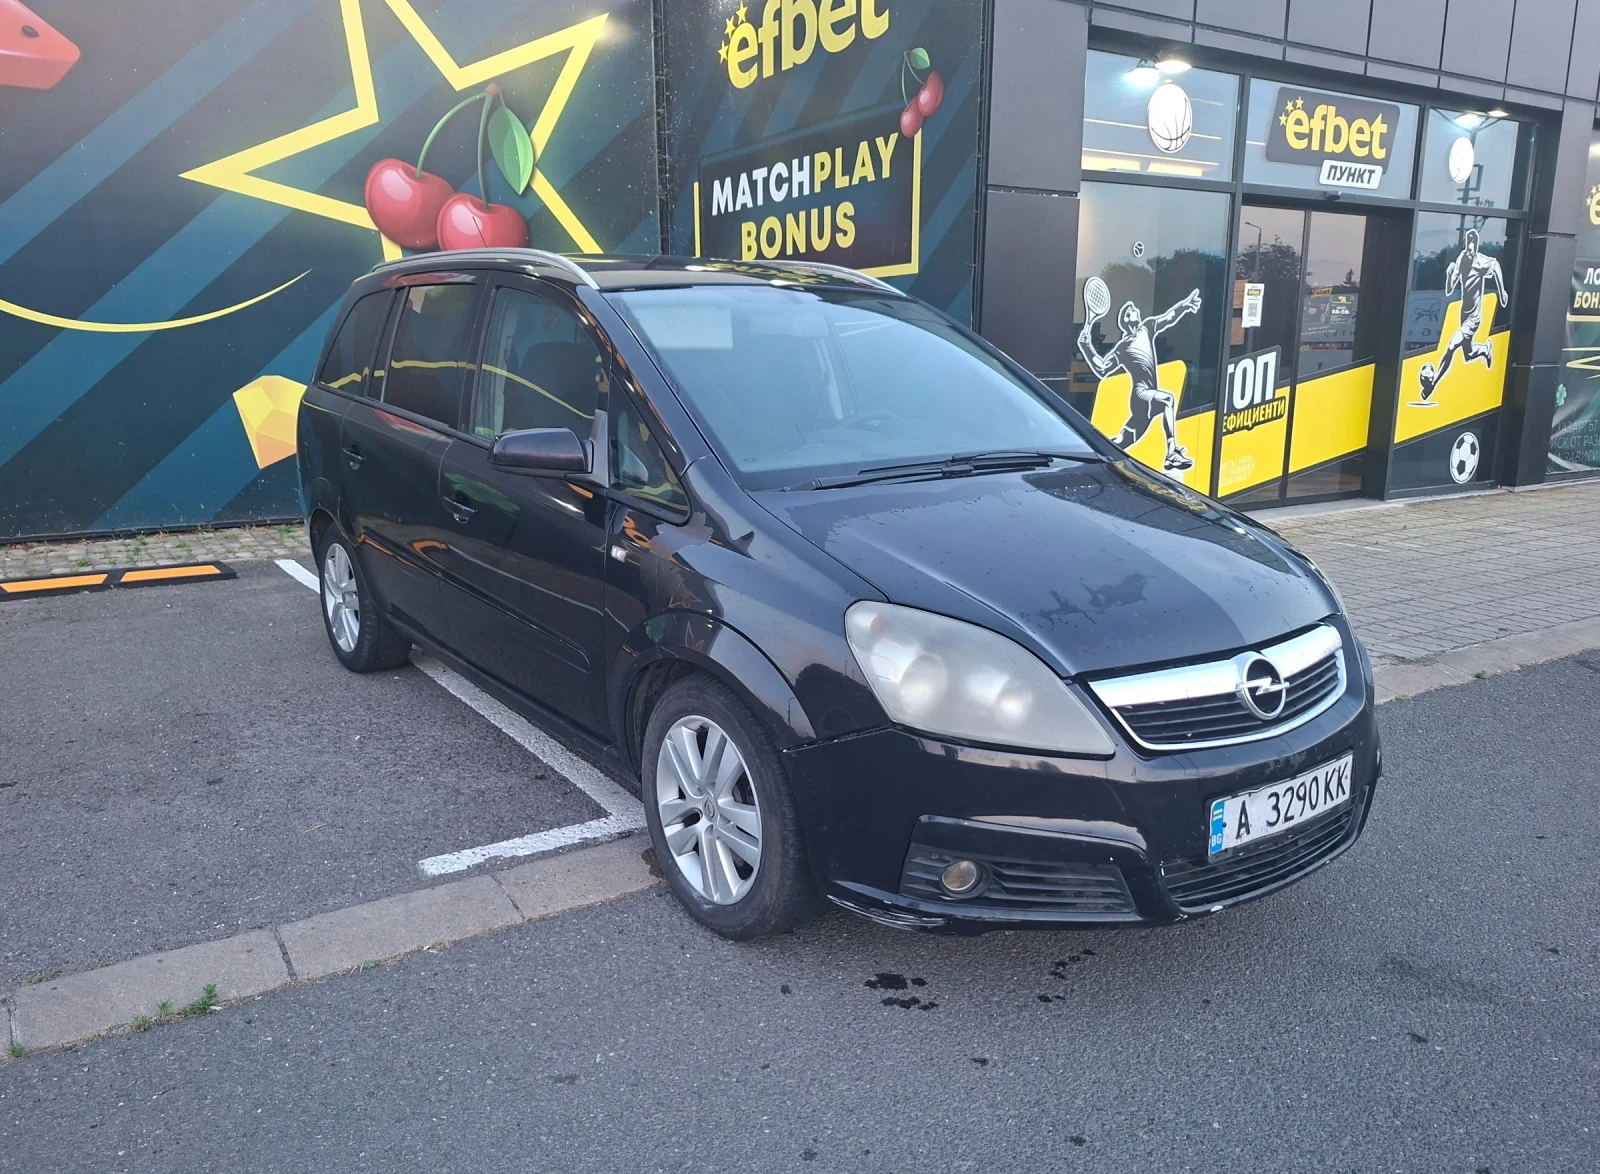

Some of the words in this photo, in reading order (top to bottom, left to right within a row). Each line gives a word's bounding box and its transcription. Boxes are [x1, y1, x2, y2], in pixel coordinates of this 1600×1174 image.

[1286, 104, 1388, 160] efbet
[1327, 165, 1376, 184] ПУНКТ
[741, 201, 856, 261] BONUS
[1573, 291, 1600, 309] БОН
[1583, 434, 1600, 447] РАЗ
[1211, 834, 1222, 846] BG
